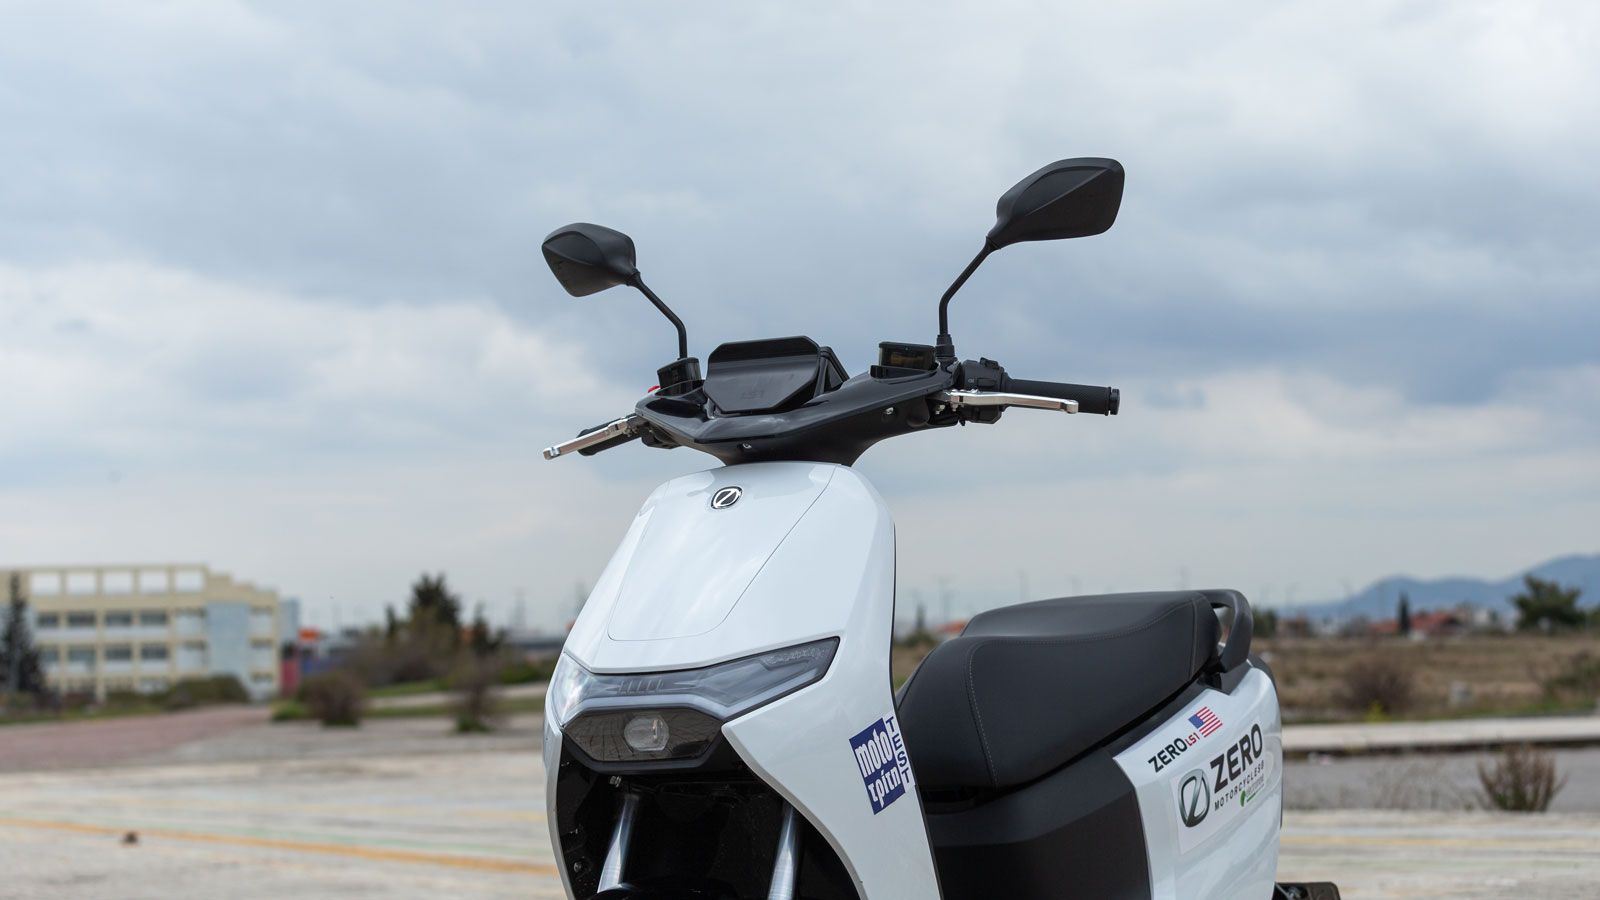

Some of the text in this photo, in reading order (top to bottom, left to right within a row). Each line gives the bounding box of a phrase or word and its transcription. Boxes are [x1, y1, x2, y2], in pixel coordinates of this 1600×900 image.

[854, 728, 893, 778] moto
[885, 716, 910, 784] TEST
[1148, 732, 1201, 773] ZERO LS1
[1209, 723, 1263, 794] ZERO
[868, 766, 901, 808] τρίτη
